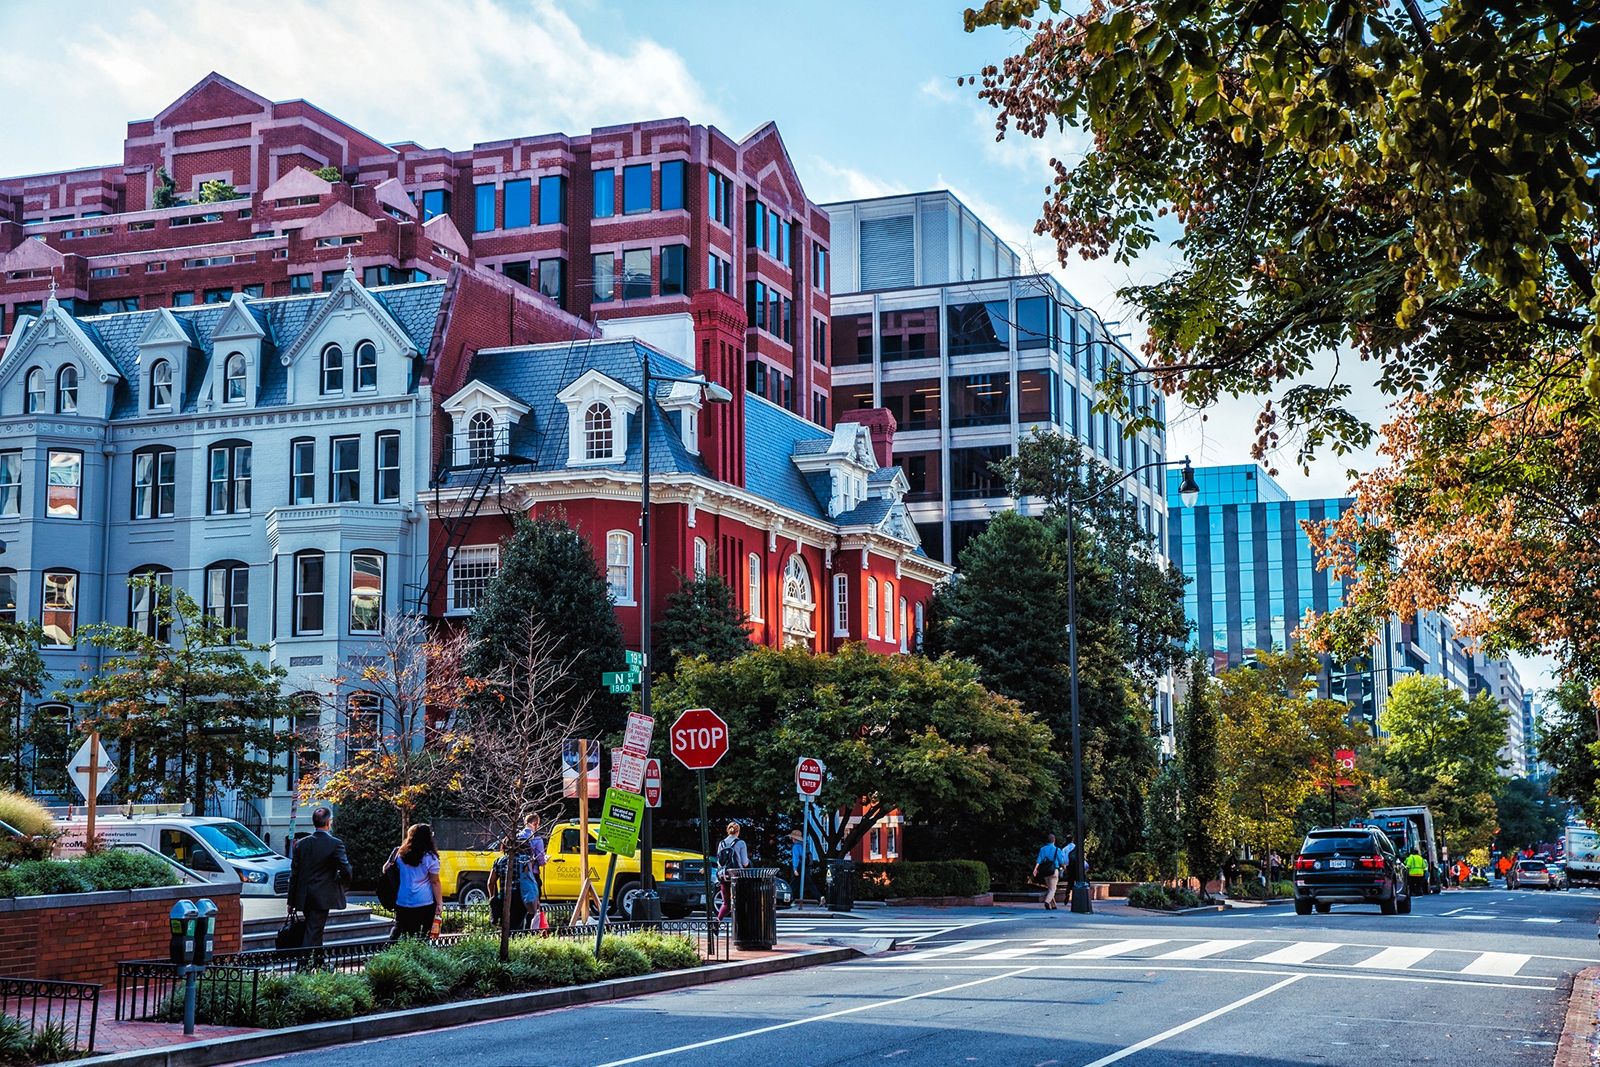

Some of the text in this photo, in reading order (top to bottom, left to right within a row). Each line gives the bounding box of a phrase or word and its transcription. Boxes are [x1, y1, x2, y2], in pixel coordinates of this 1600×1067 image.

[630, 653, 638, 664] 19
[615, 673, 624, 684] N
[631, 723, 649, 732] STANDING
[634, 730, 650, 738] PARKING
[675, 727, 724, 751] STOP
[648, 790, 658, 798] ENTER
[612, 806, 628, 815] Located
